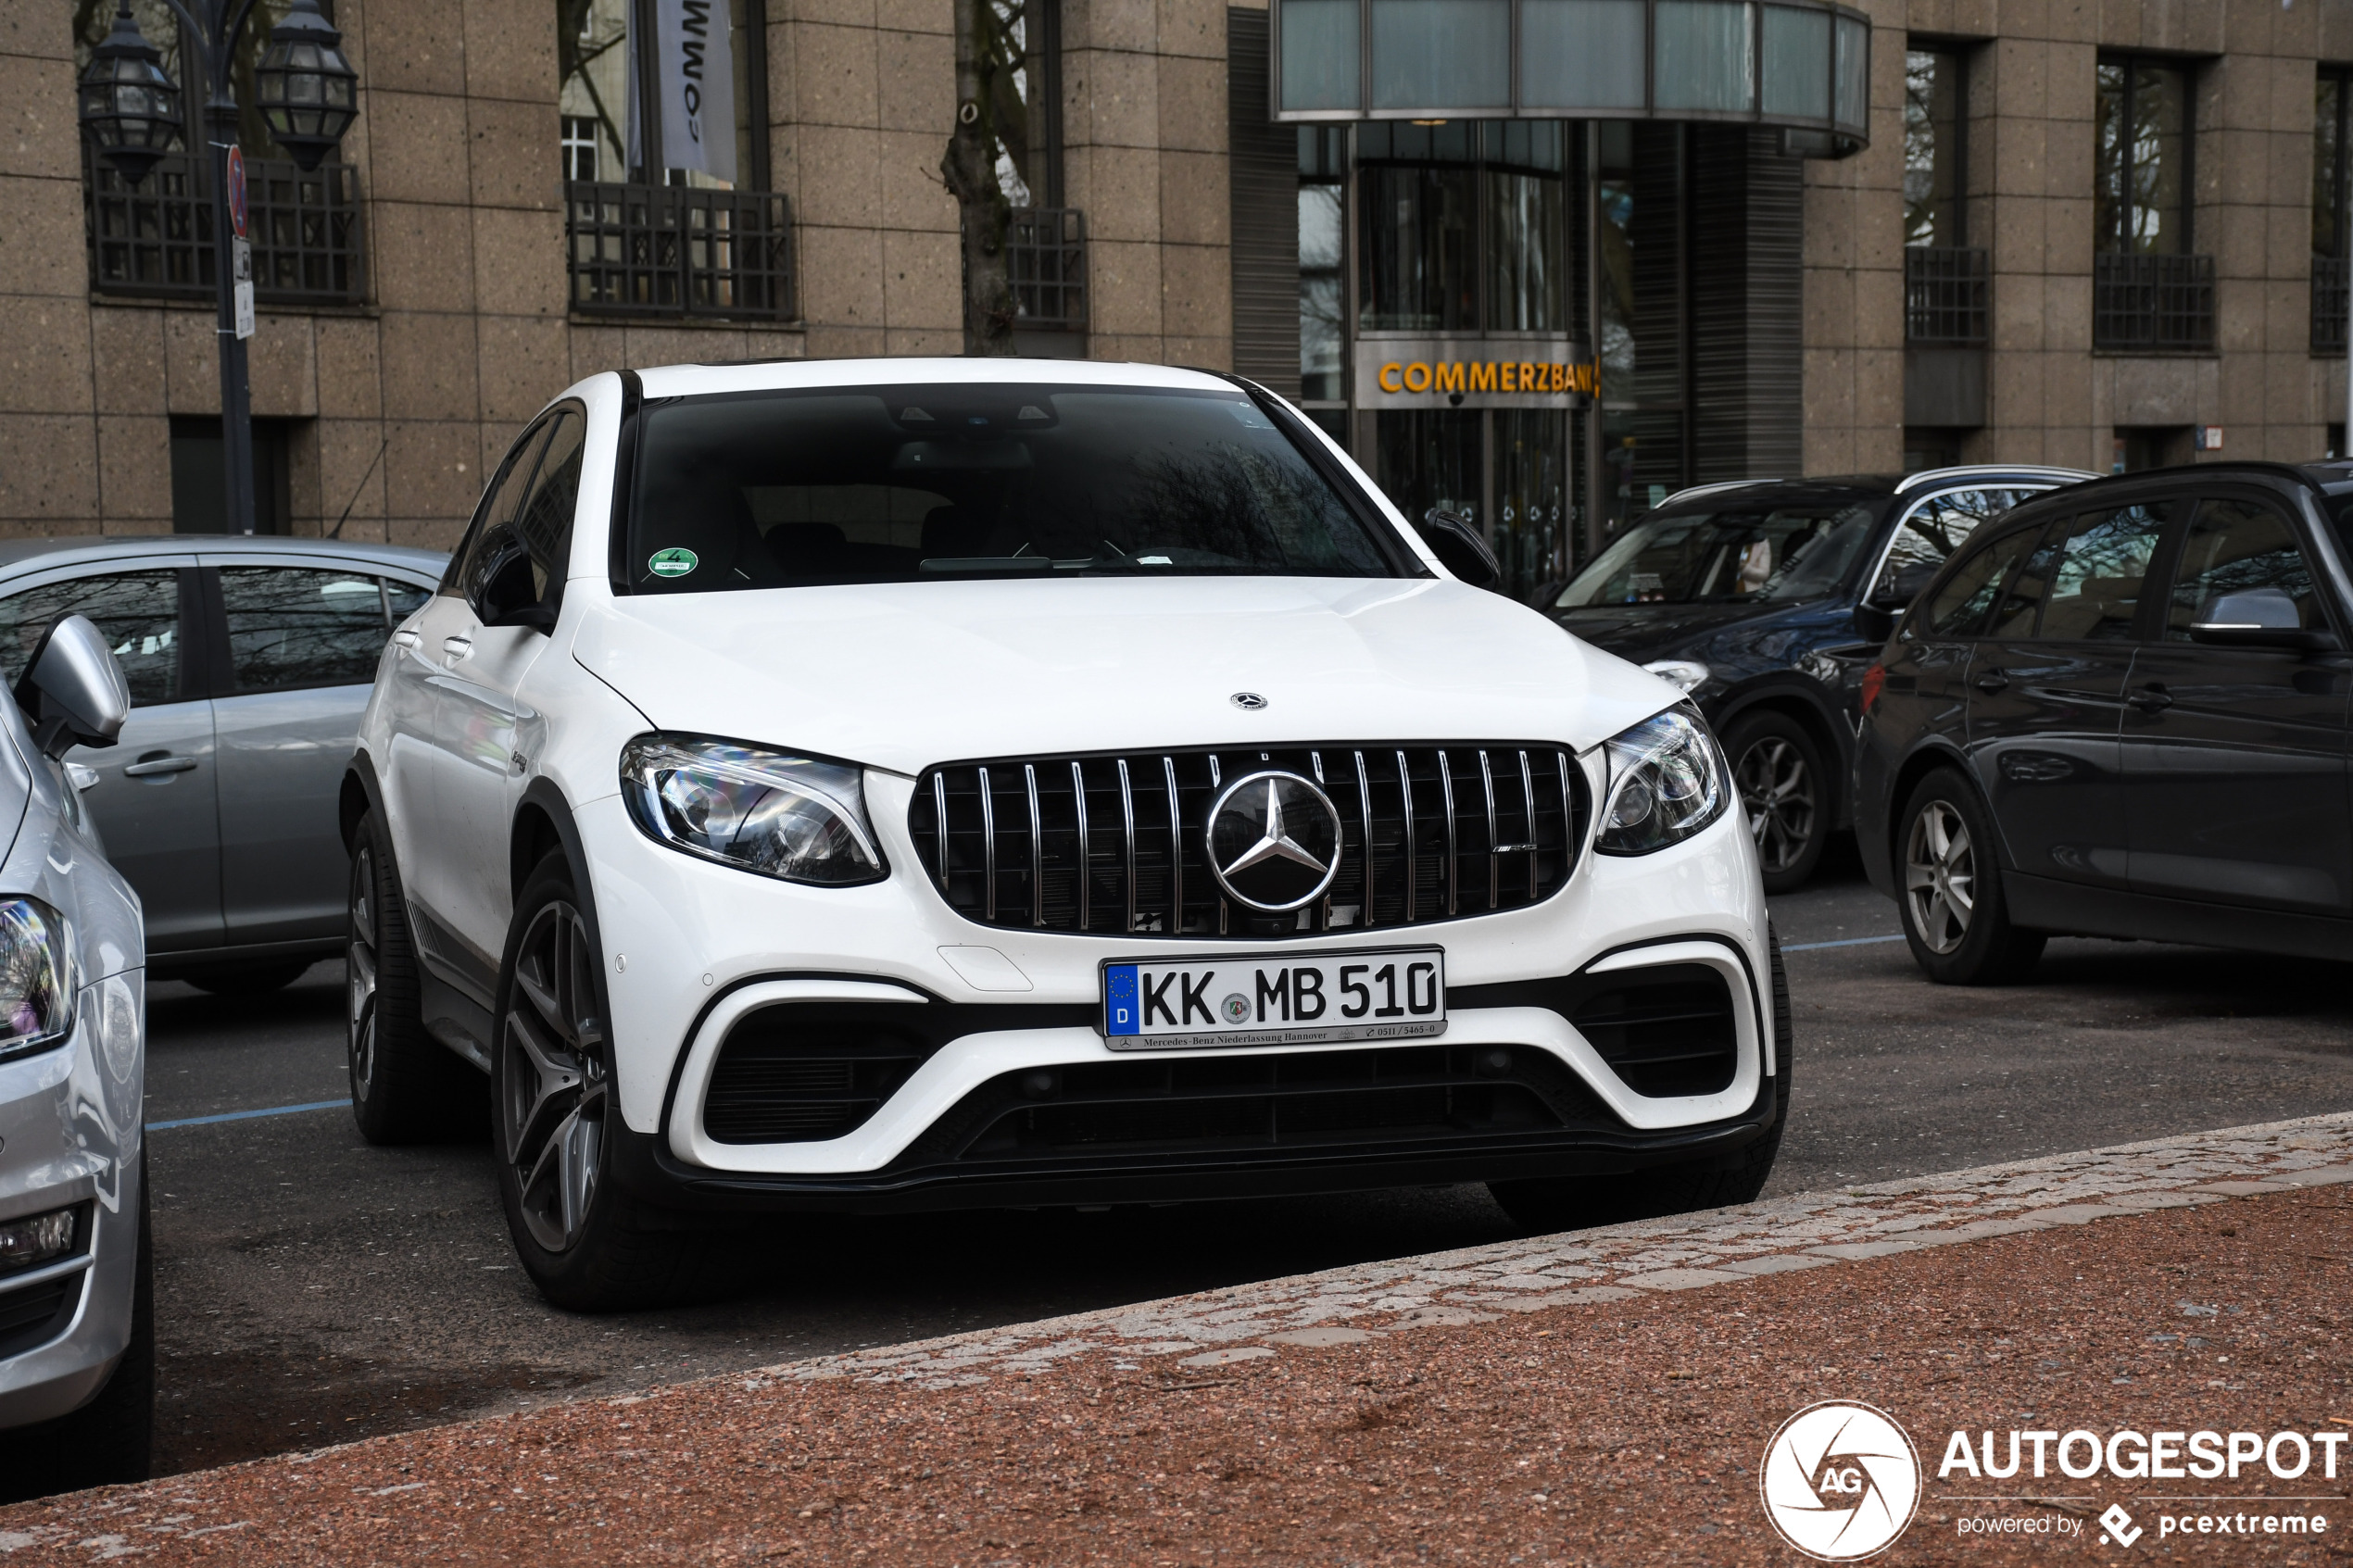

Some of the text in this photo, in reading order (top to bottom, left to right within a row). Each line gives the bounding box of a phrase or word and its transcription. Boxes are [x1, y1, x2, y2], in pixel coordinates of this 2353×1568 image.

[1378, 361, 1593, 393] COMMERZBANK
[1143, 971, 1216, 1026] KK
[1255, 967, 1327, 1022] MB
[1340, 961, 1437, 1018] 510
[1116, 1008, 1128, 1023] D
[1144, 1036, 1214, 1047] Mercedes-Benz
[1217, 1034, 1282, 1044] Niederlassung
[1284, 1032, 1327, 1041] Hannover
